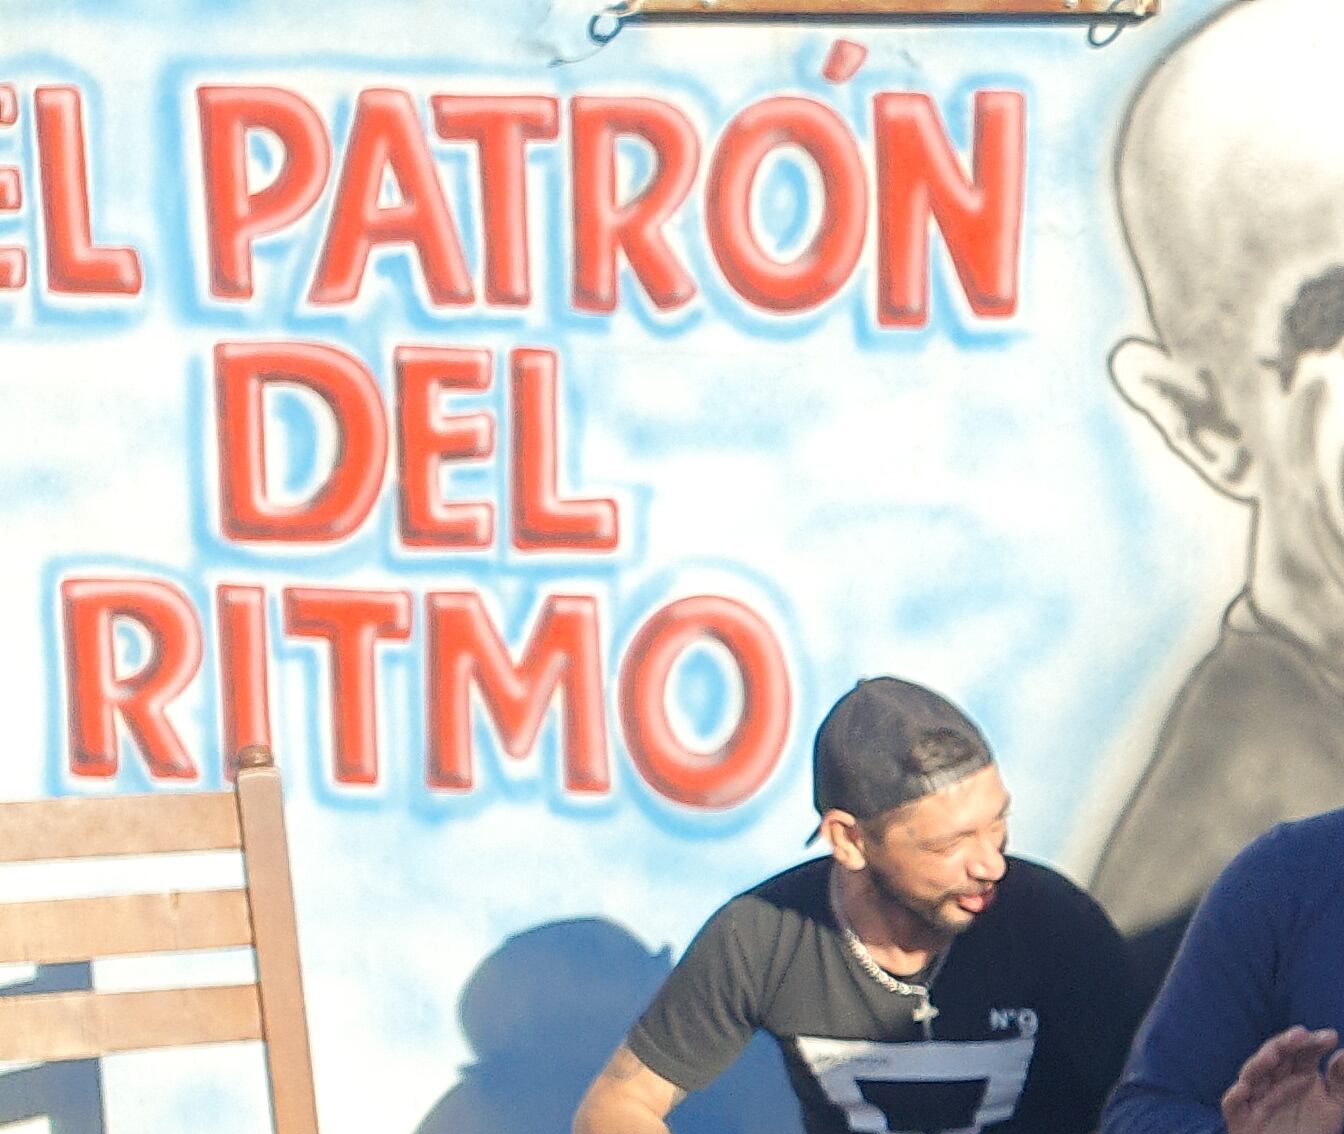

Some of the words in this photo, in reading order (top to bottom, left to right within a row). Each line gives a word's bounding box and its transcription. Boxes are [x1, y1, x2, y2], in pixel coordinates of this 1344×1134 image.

[0, 83, 141, 294] L
[196, 38, 1027, 329] PATRÓN
[213, 341, 619, 552] DEL
[60, 577, 793, 811] RITMO
